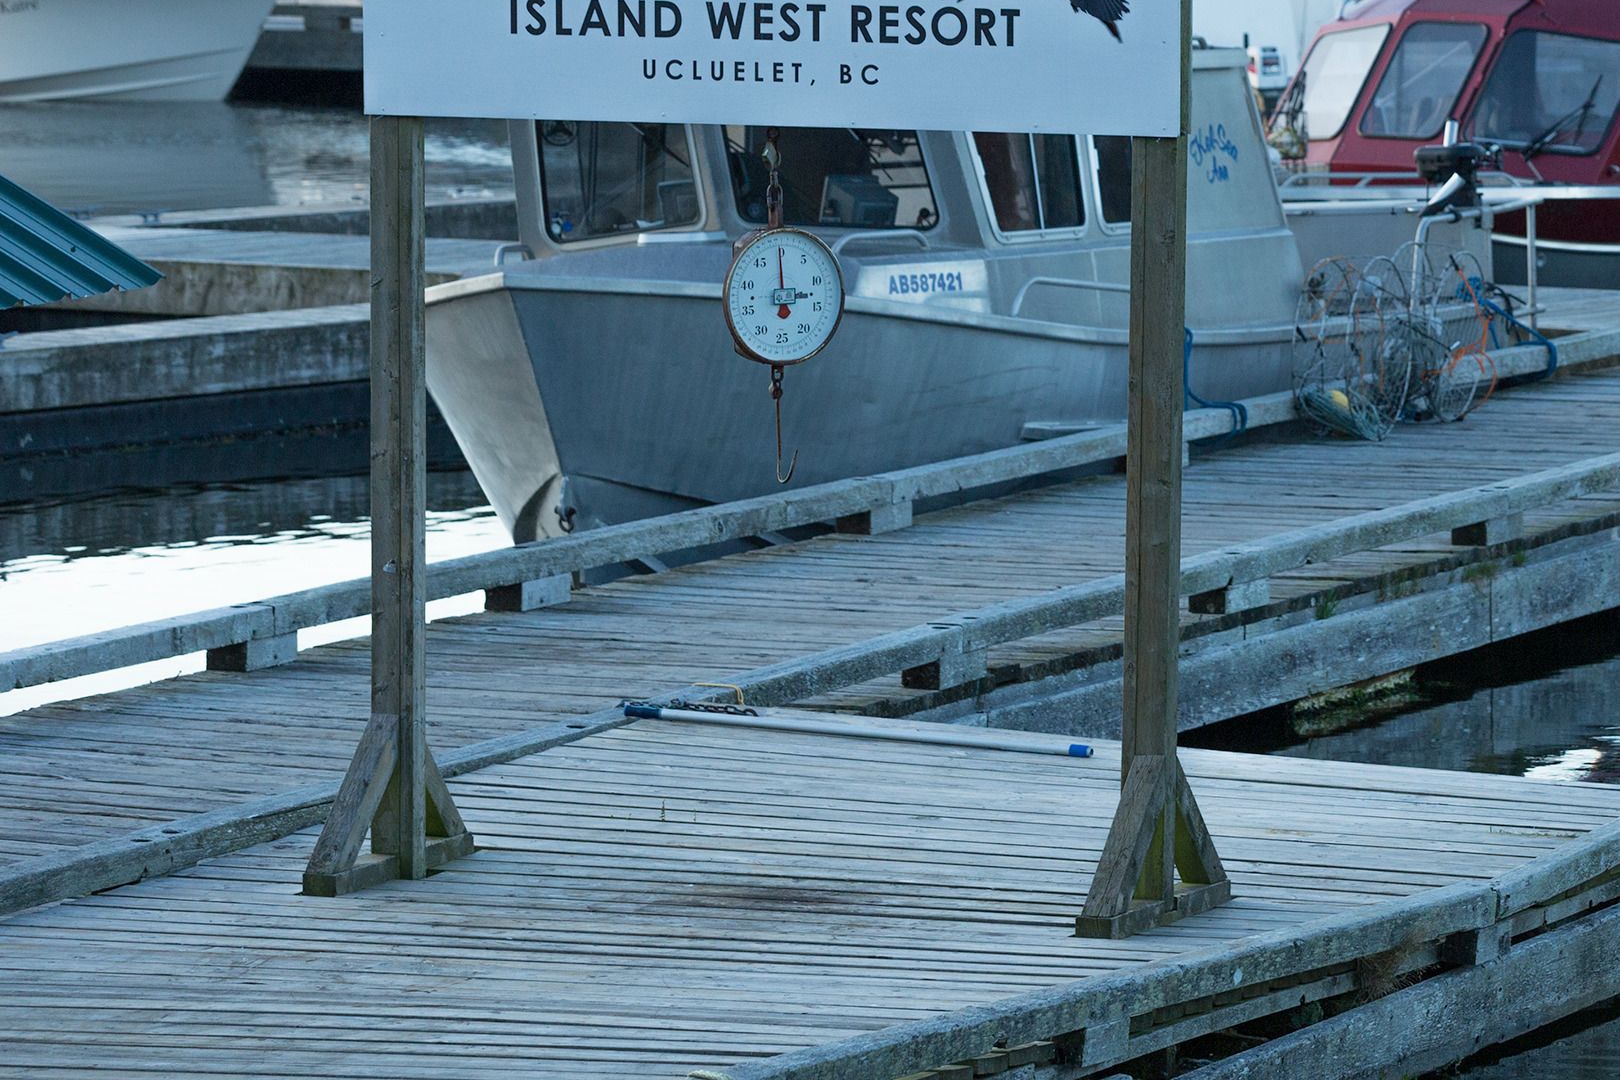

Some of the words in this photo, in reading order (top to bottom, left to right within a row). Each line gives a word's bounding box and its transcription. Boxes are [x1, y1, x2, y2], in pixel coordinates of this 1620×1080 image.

[705, 0, 827, 42] WEST
[850, 4, 1021, 47] RESORT
[642, 58, 816, 87] UCLUELET,
[839, 63, 880, 86] BC
[752, 257, 767, 269] 45
[799, 254, 808, 265] 5
[740, 279, 755, 291] 40
[811, 275, 822, 287] 10
[888, 271, 963, 295] AB587421
[741, 304, 755, 317] 35
[812, 301, 823, 313] 15
[754, 324, 768, 336] 30
[797, 322, 811, 335] 20
[775, 332, 789, 344] 25
